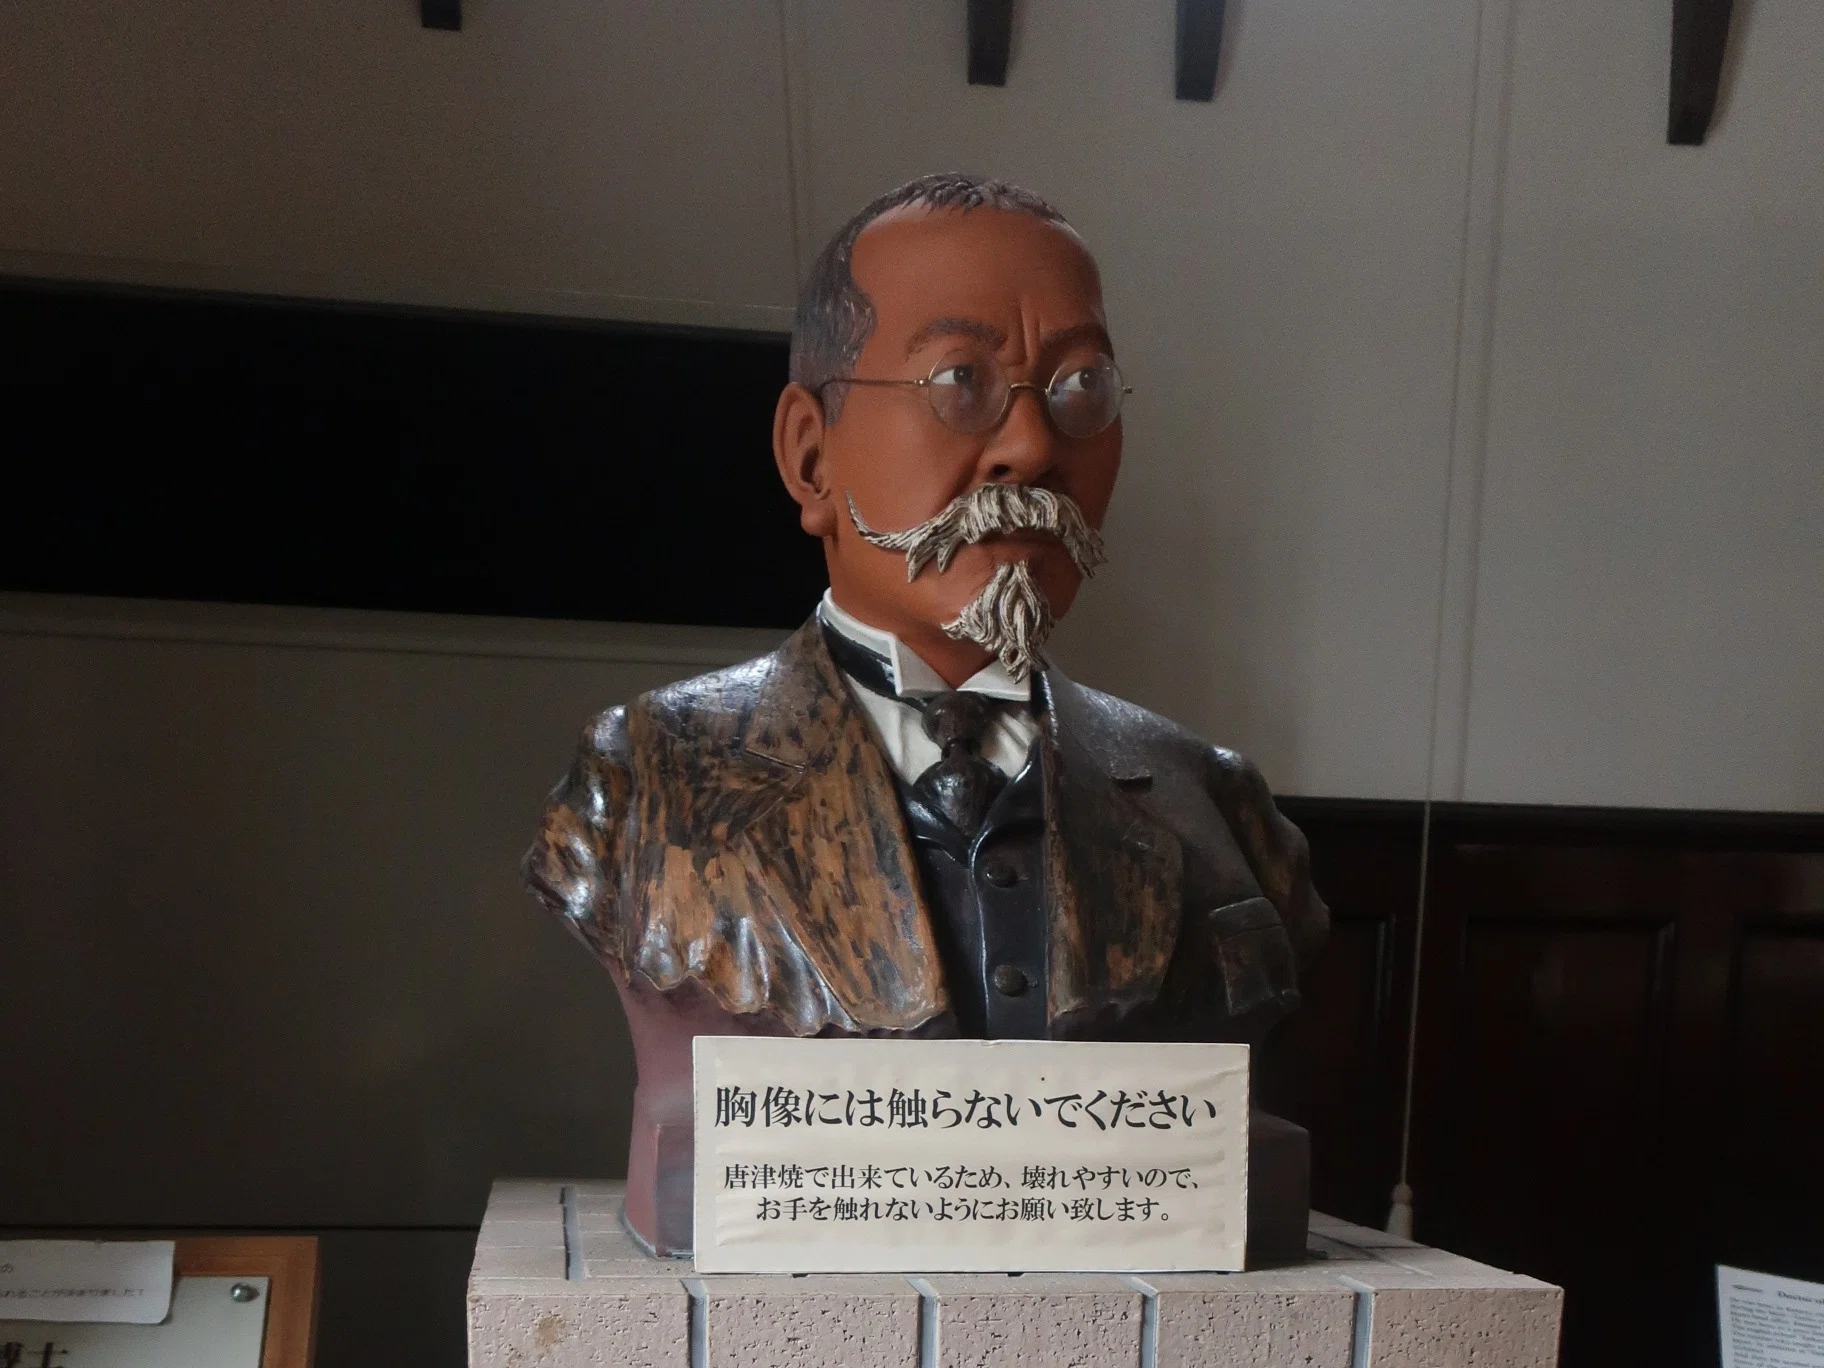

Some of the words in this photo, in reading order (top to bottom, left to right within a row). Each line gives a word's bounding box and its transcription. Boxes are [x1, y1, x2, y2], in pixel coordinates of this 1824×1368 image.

[714, 1086, 1217, 1131] 胸像には触らないでください
[724, 1163, 1199, 1191] 唐津焼で出来ているため、壊れやすいので、
[756, 1196, 1170, 1223] お手を触れないようにお願い致します。
